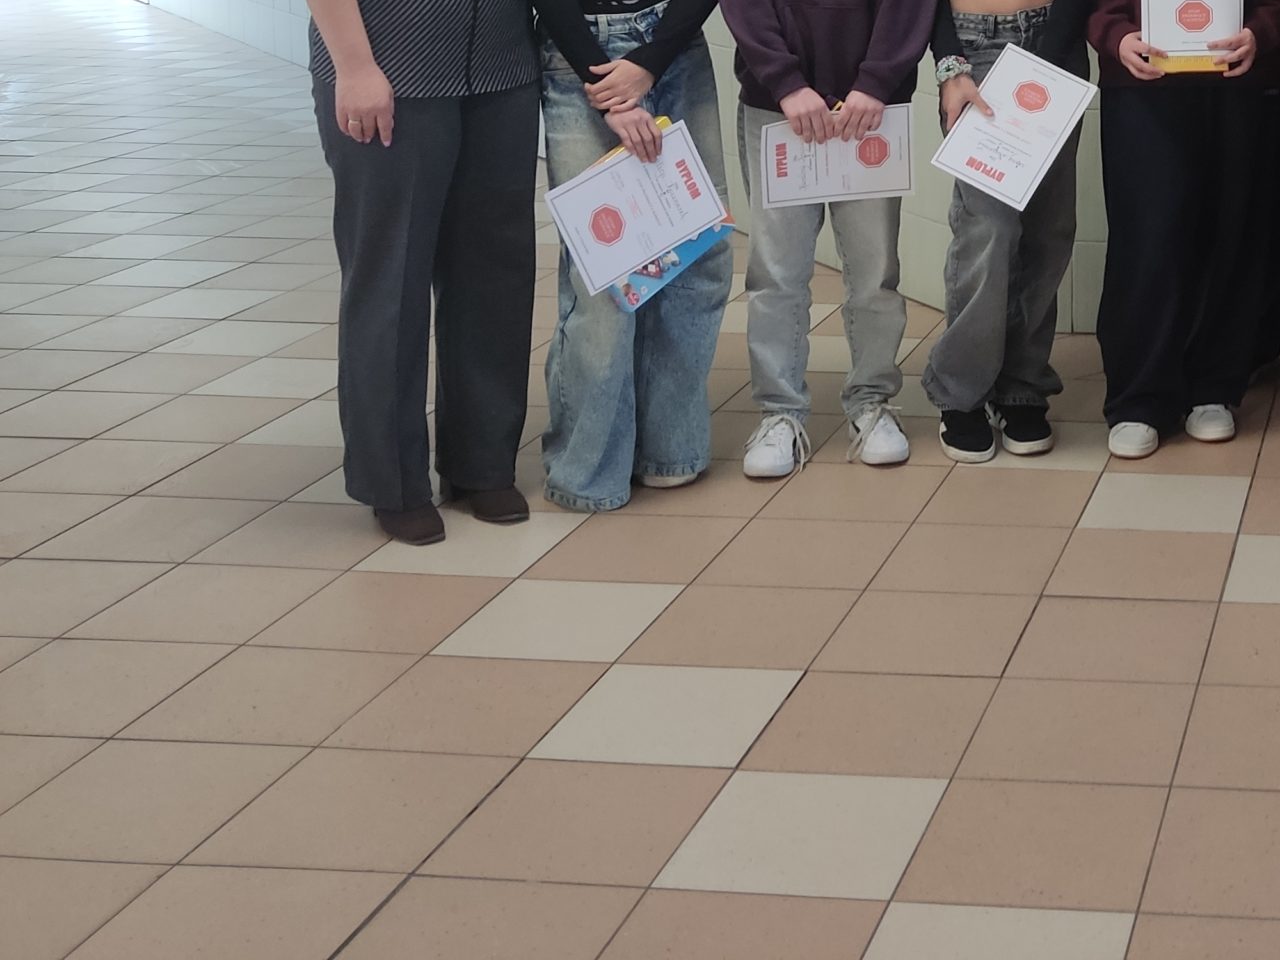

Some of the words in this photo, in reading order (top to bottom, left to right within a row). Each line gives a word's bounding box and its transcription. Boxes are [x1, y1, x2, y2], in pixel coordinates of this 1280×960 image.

[774, 142, 789, 178] DYPLOM
[965, 155, 1006, 183] DYPLOM
[675, 158, 702, 201] DYPLOM
